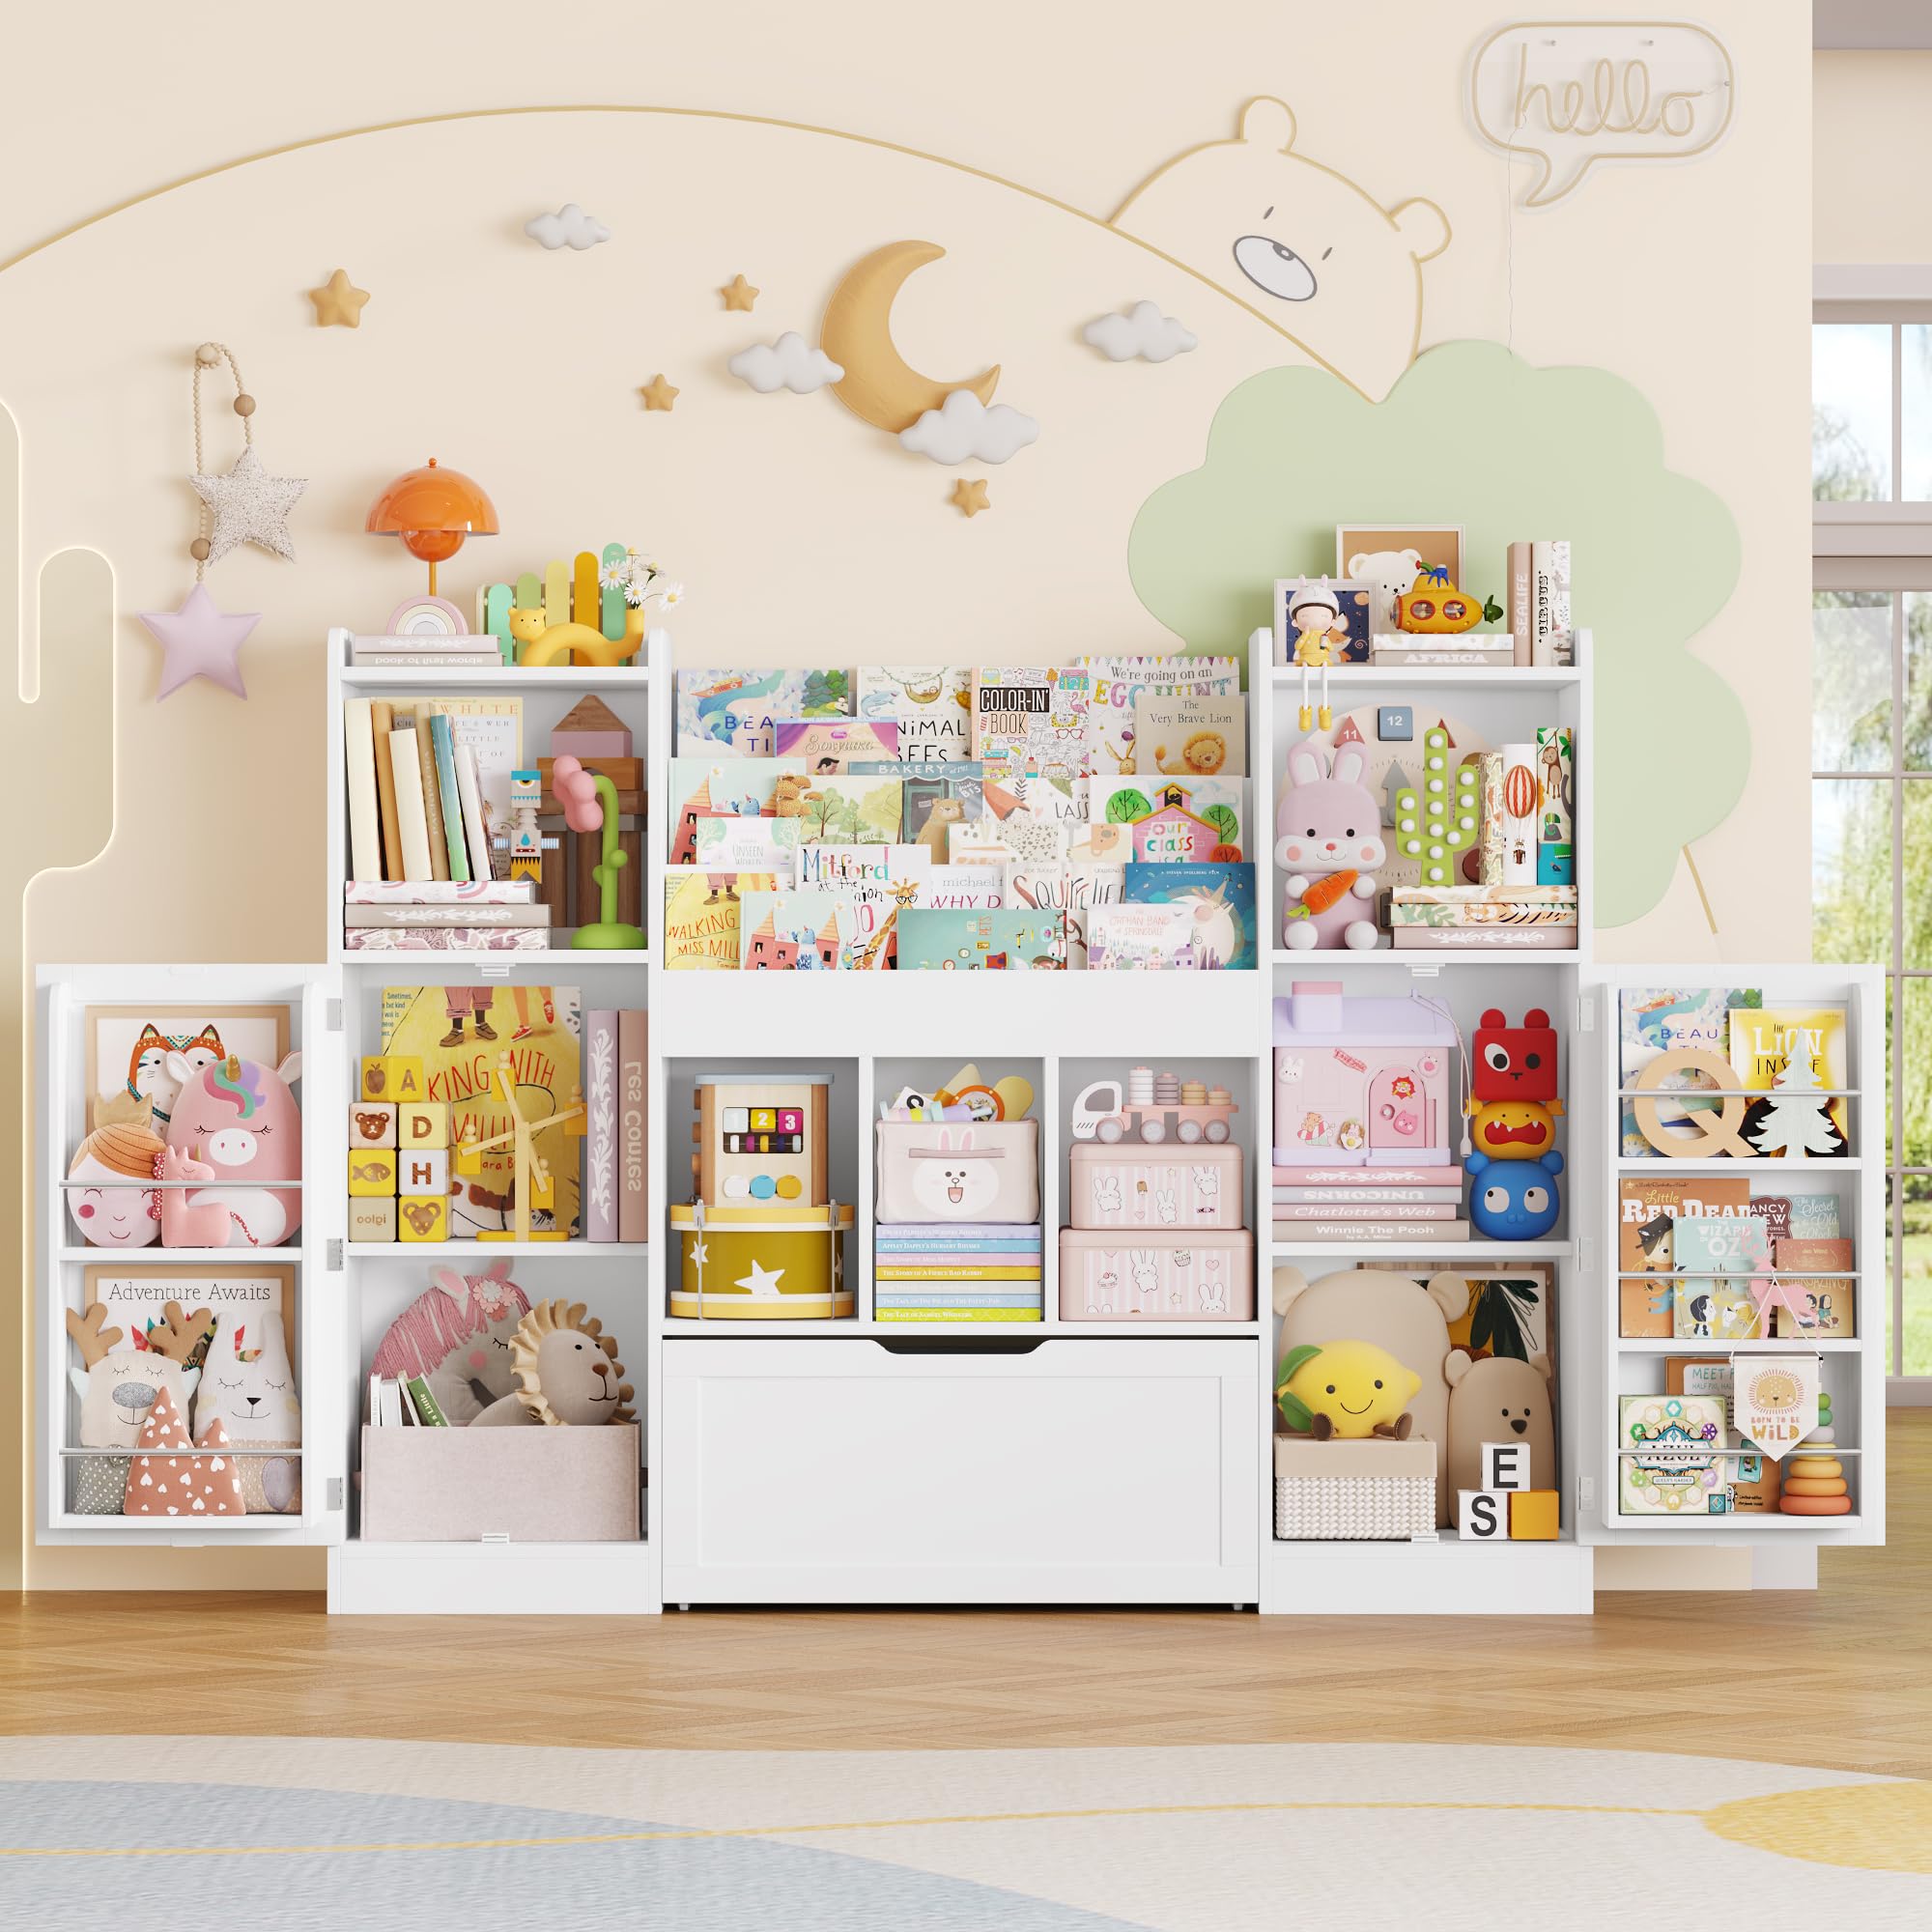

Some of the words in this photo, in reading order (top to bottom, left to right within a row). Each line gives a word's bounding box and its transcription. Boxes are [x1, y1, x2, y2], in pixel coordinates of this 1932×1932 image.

[1513, 43, 1703, 137] hello
[1516, 573, 1528, 636] SEALIFE
[1405, 654, 1489, 664] AFRICA
[1111, 667, 1141, 679] We're
[1144, 670, 1177, 684] going
[1179, 669, 1195, 680] on
[1198, 668, 1212, 678] an
[1181, 700, 1199, 710] The
[990, 713, 1027, 734] BOOK
[1150, 713, 1173, 726] Very
[1178, 713, 1206, 724] Brave
[1209, 713, 1233, 724] Lion
[1387, 715, 1404, 726] 12
[1344, 729, 1358, 740] 11
[878, 764, 946, 774] BAKERY
[1147, 836, 1193, 851] class
[802, 846, 891, 883] Mitford
[943, 875, 999, 887] michael
[930, 895, 979, 909] WHY
[668, 909, 735, 939] WALKING
[678, 940, 704, 955] MISS
[401, 1068, 416, 1092] A
[1634, 1048, 1759, 1158] Q
[412, 1116, 433, 1139] D
[758, 1112, 768, 1126] 2
[784, 1114, 796, 1130] 3
[412, 1163, 432, 1185] H
[1303, 1190, 1425, 1200] UNICORNS
[1644, 1189, 1680, 1205] Little
[1399, 1207, 1436, 1217] Web
[1316, 1226, 1364, 1235] Winnie
[1368, 1226, 1394, 1235] The
[1398, 1226, 1435, 1235] Pooh
[1708, 1236, 1741, 1257] OZ
[108, 1281, 202, 1301] Adventure
[209, 1283, 270, 1301] Awaits
[1691, 1367, 1725, 1380] MEET
[1492, 1448, 1520, 1489] E
[1470, 1495, 1498, 1537] S
